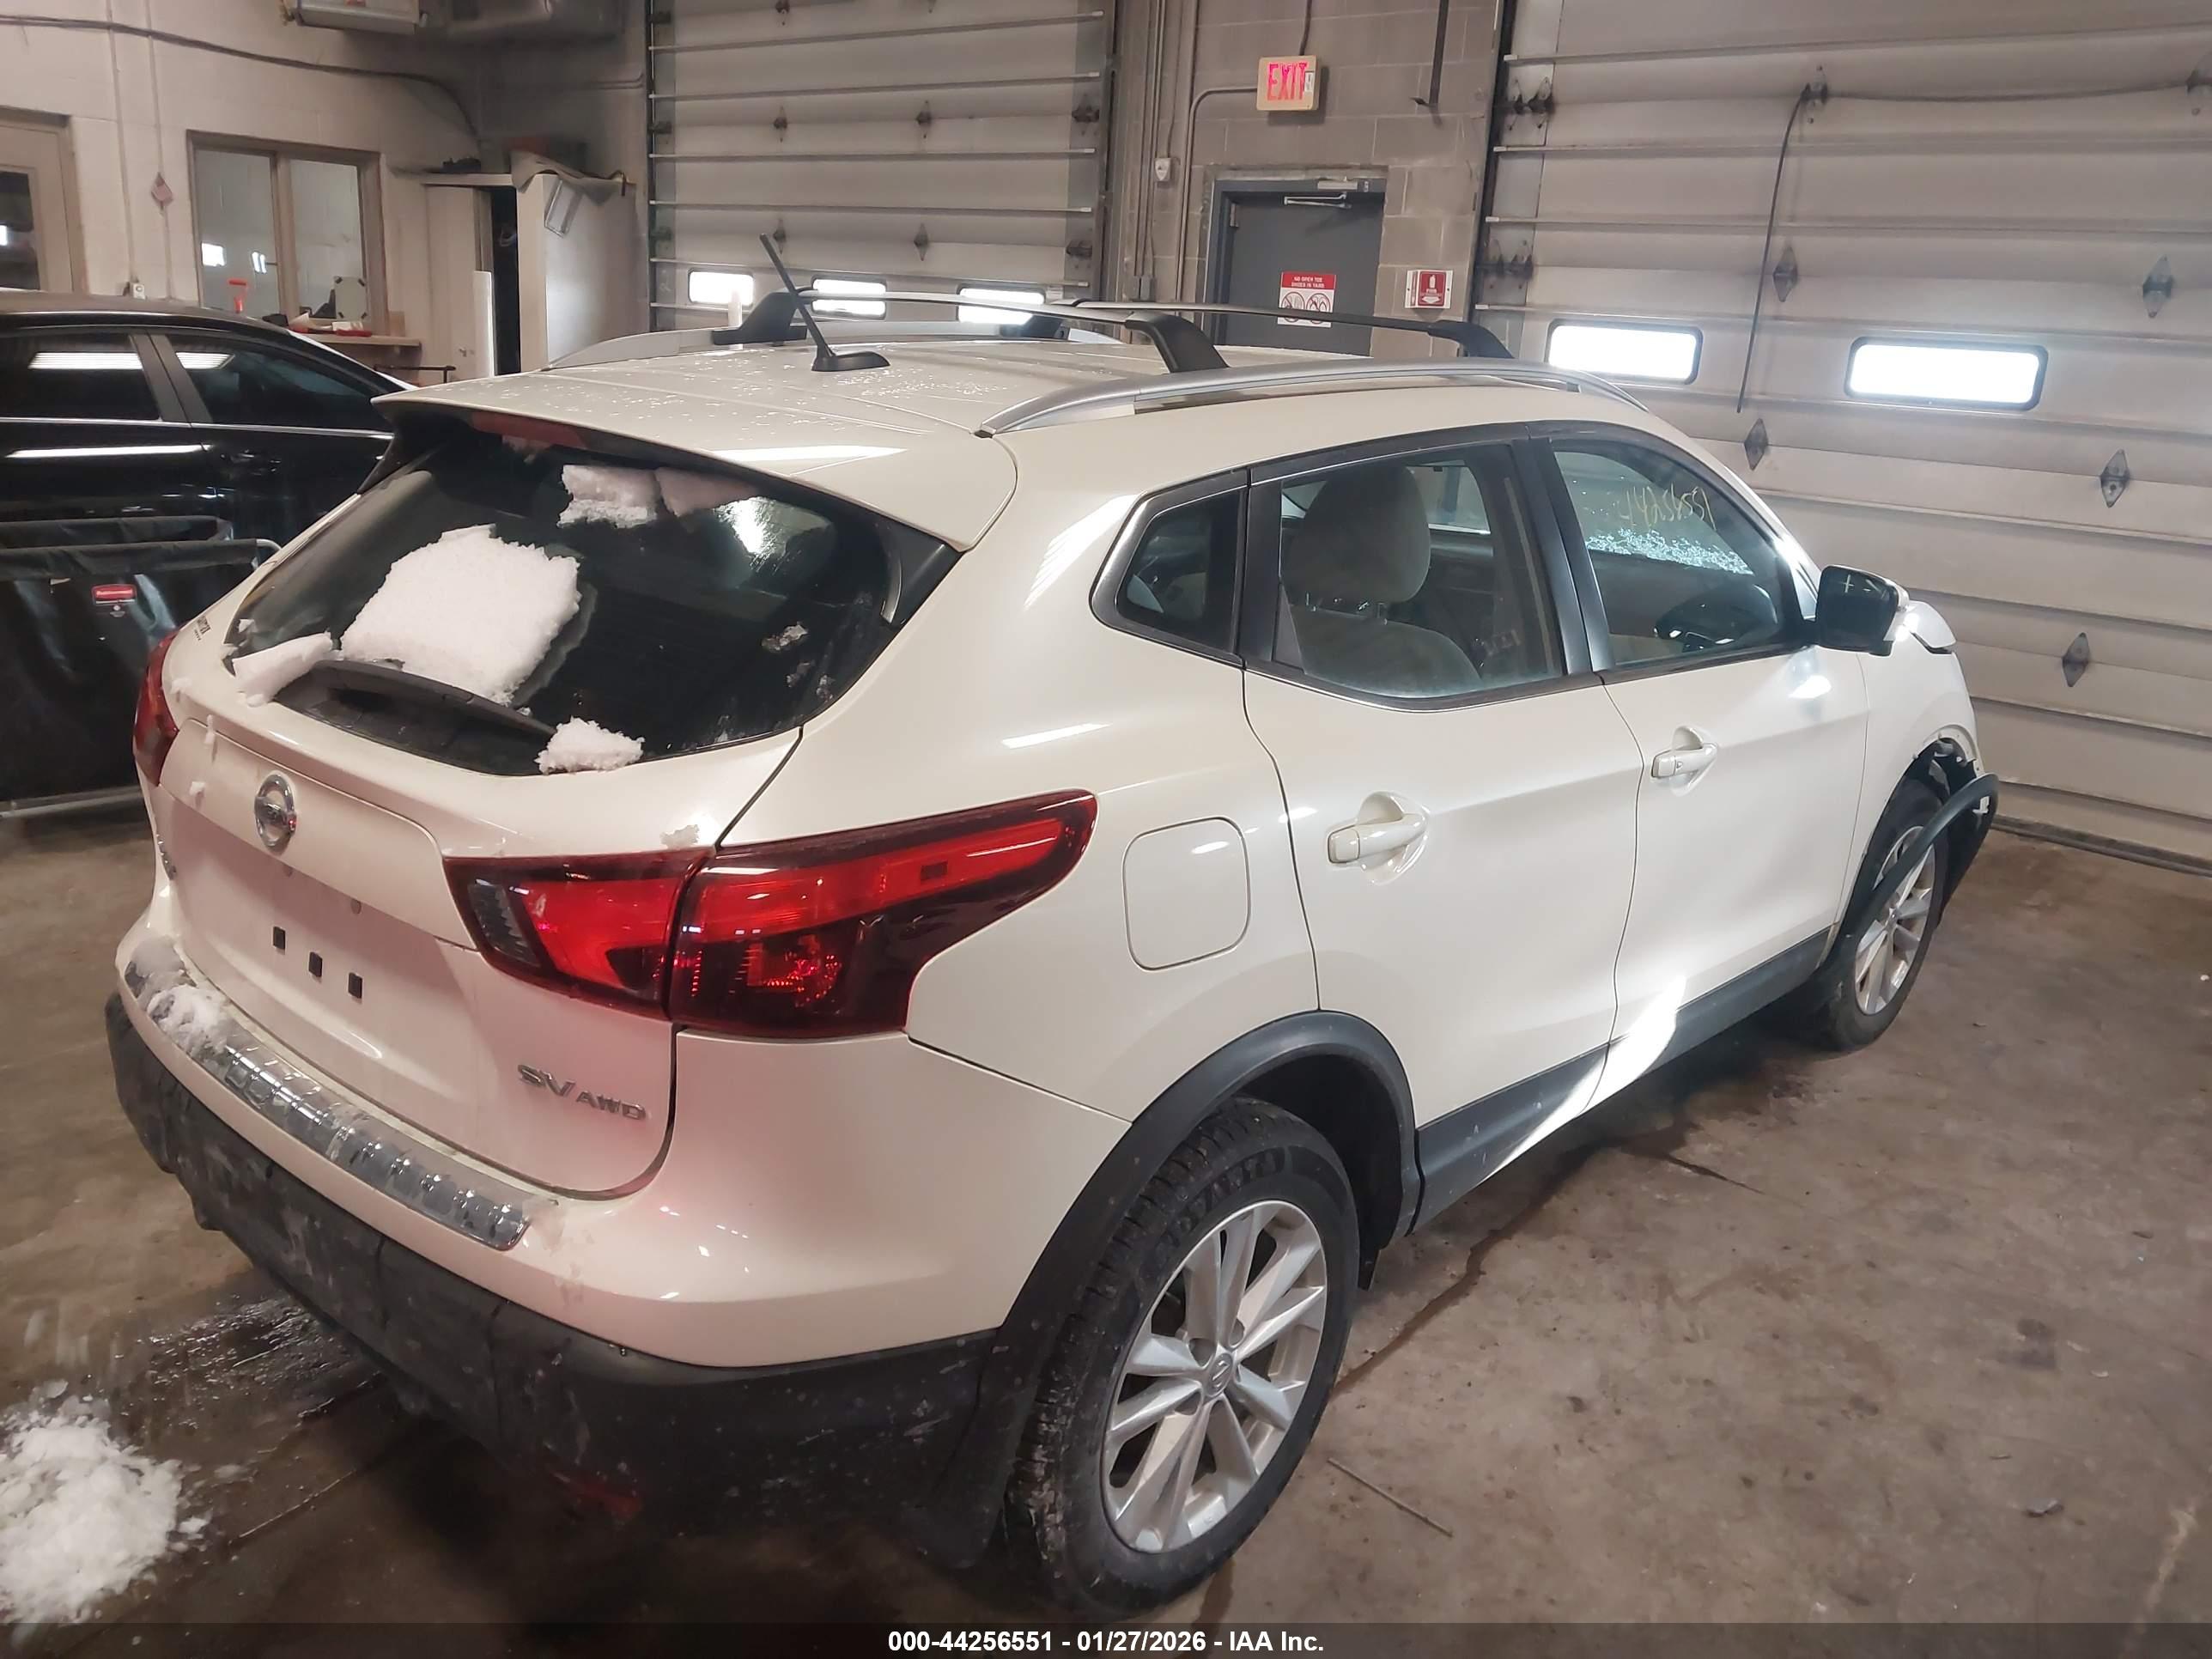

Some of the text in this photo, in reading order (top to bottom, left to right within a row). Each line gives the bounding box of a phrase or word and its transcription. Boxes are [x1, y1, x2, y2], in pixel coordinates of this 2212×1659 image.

[1267, 63, 1307, 100] EXIT
[517, 1064, 647, 1121] SV AWD
